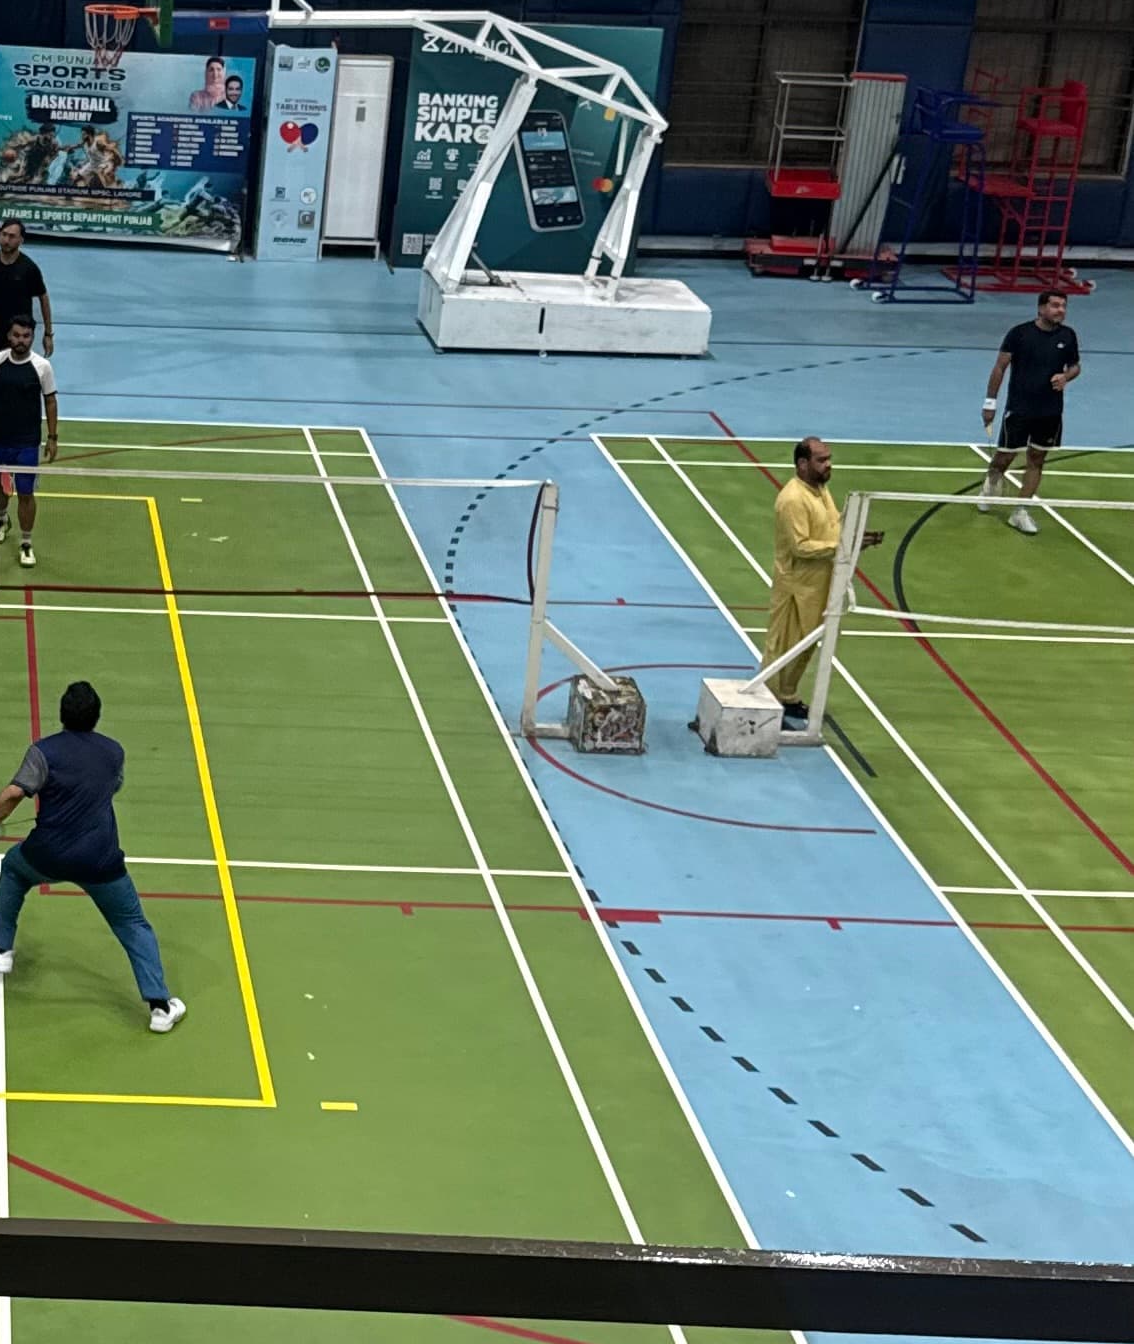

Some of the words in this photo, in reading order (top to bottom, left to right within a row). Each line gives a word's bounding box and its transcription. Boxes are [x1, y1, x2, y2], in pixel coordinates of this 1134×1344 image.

[32, 54, 52, 63] CM
[14, 63, 126, 81] SPORTS
[17, 78, 122, 91] ACADEMIES
[31, 94, 111, 113] BASKETBALL
[418, 92, 499, 108] BANKING
[300, 104, 328, 112] TENNIS
[50, 110, 93, 122] ACADEMY
[417, 107, 497, 124] SIMPLE
[29, 186, 57, 194] PUNJAB
[2, 208, 32, 220] AFFAIRS
[42, 211, 72, 222] SPORTS
[73, 213, 122, 225] DEPARTMENT
[123, 216, 153, 226] PUNJAB
